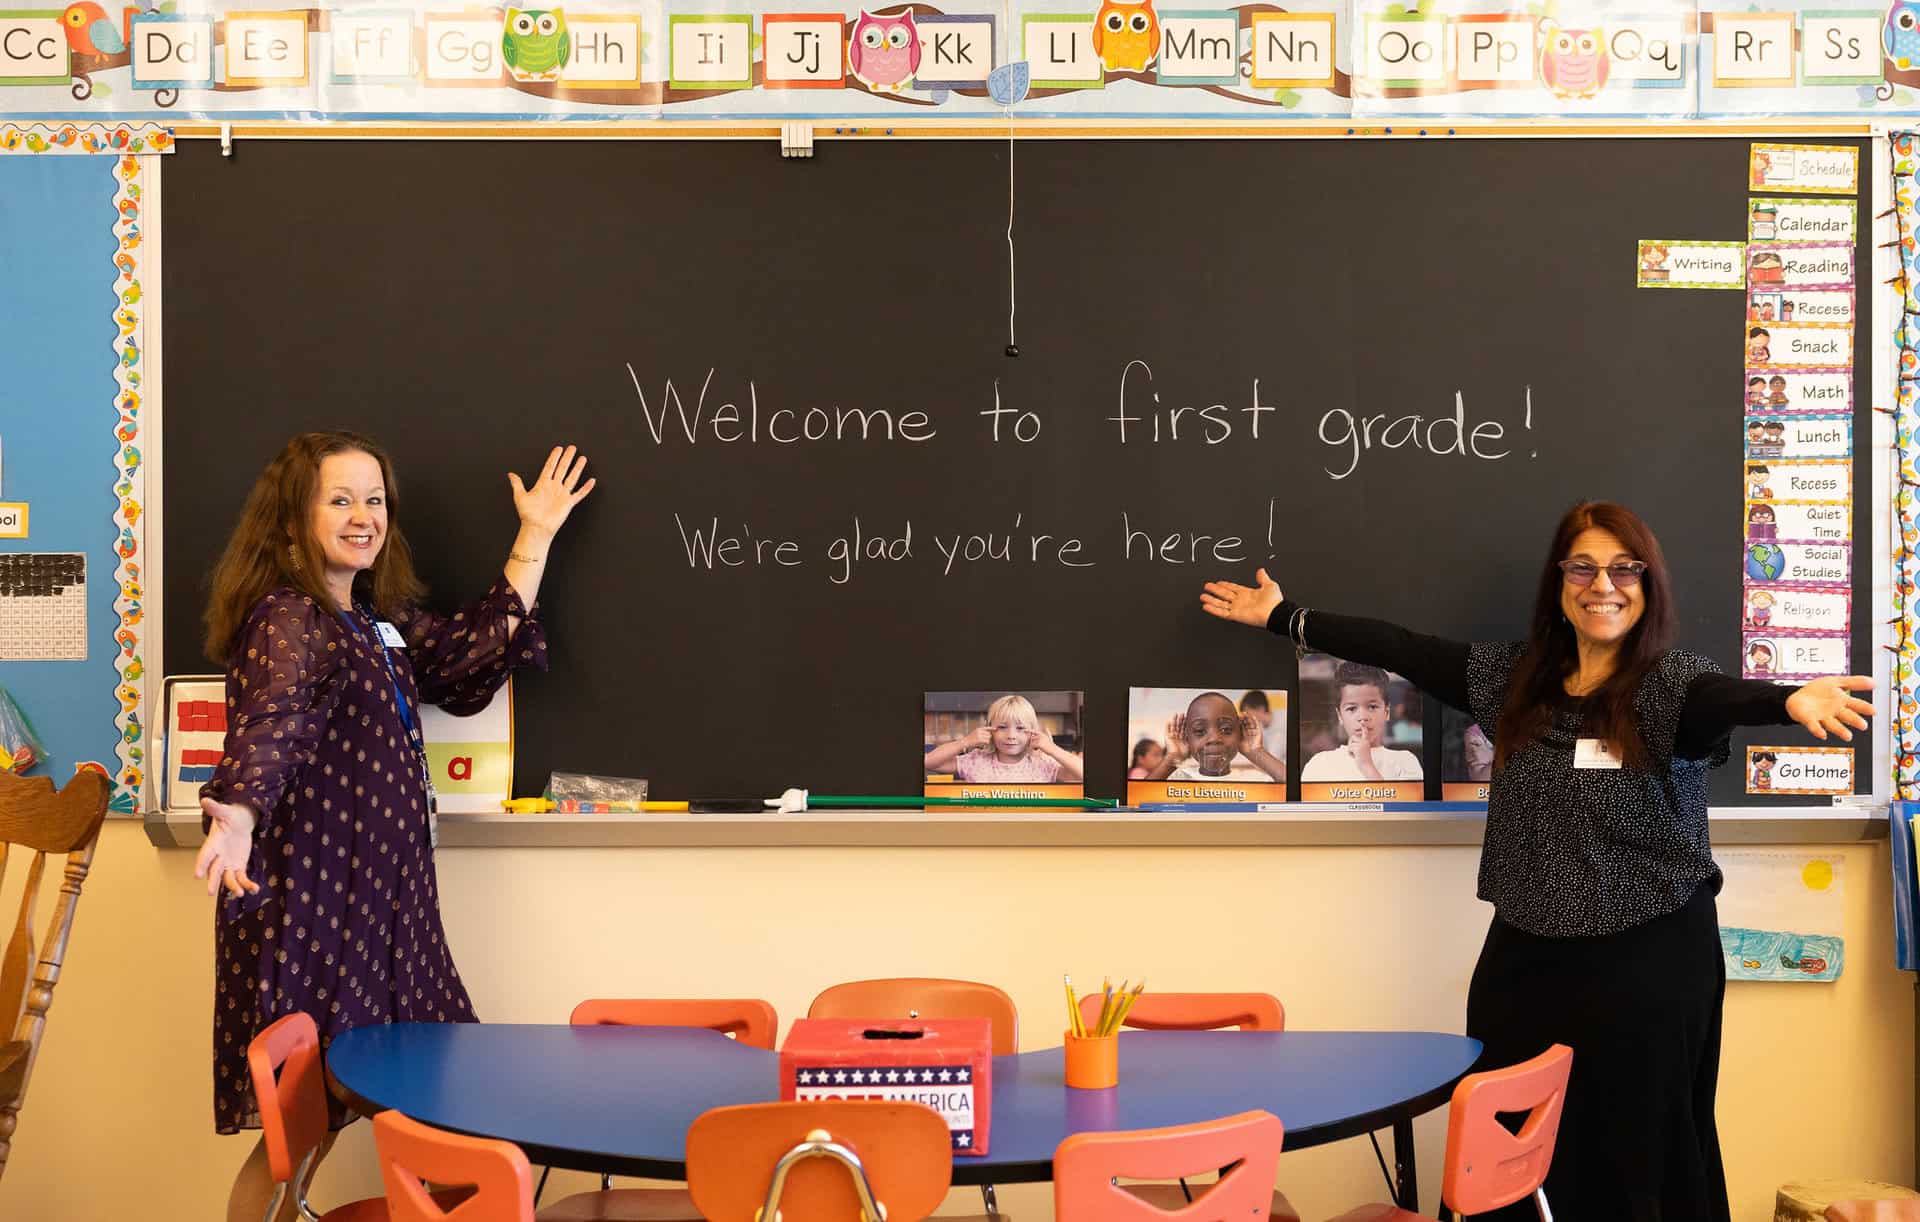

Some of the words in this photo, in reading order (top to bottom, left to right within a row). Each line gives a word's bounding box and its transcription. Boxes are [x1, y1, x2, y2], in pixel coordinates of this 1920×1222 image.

[4, 28, 56, 60] Cc
[146, 32, 198, 64] Dd
[244, 29, 289, 61] Ee
[354, 27, 393, 60] Ff
[438, 31, 492, 72] Gg
[576, 32, 623, 63] Hh
[697, 32, 724, 64] Ii
[787, 32, 819, 73] Jj
[935, 33, 972, 64] Kk
[1051, 32, 1075, 63] Ll
[1166, 29, 1230, 59] Mm
[1269, 32, 1317, 62] Nn
[1378, 31, 1433, 63] Oo
[1474, 32, 1518, 73] Pp
[1611, 29, 1678, 71] Qq
[1734, 31, 1774, 62] Rr
[1824, 28, 1861, 60] Ss
[1799, 160, 1852, 177] Schedule
[1780, 217, 1848, 231] Calendar
[1675, 259, 1731, 272] Writing
[1787, 259, 1849, 276] Reading
[1799, 303, 1849, 315] Recess
[1792, 339, 1837, 353] Snack
[1803, 385, 1843, 398] Math
[627, 363, 936, 444] Welcome
[980, 382, 1040, 442] to
[1109, 360, 1275, 444] first
[1319, 387, 1536, 479] grade!
[1798, 429, 1840, 443] Lunch
[1791, 477, 1836, 490] Recess
[0, 513, 16, 526] ol
[1807, 508, 1842, 520] Quiet
[1813, 526, 1841, 538] Time
[675, 513, 803, 569] We're
[828, 518, 912, 583] glad
[936, 514, 1094, 575] you're
[1804, 548, 1842, 560] Social
[1793, 566, 1841, 577] Studies
[1783, 601, 1832, 618] Religion
[1796, 648, 1825, 662] P.E.
[448, 757, 472, 780] a
[1780, 764, 1800, 777] Go
[1806, 765, 1848, 778] Home
[961, 788, 989, 799] Eyes
[991, 788, 1046, 799] Watching
[1167, 786, 1191, 797] Ears
[1194, 788, 1247, 800] Listening
[1329, 787, 1360, 799] Voice
[1363, 788, 1397, 800] Quiet
